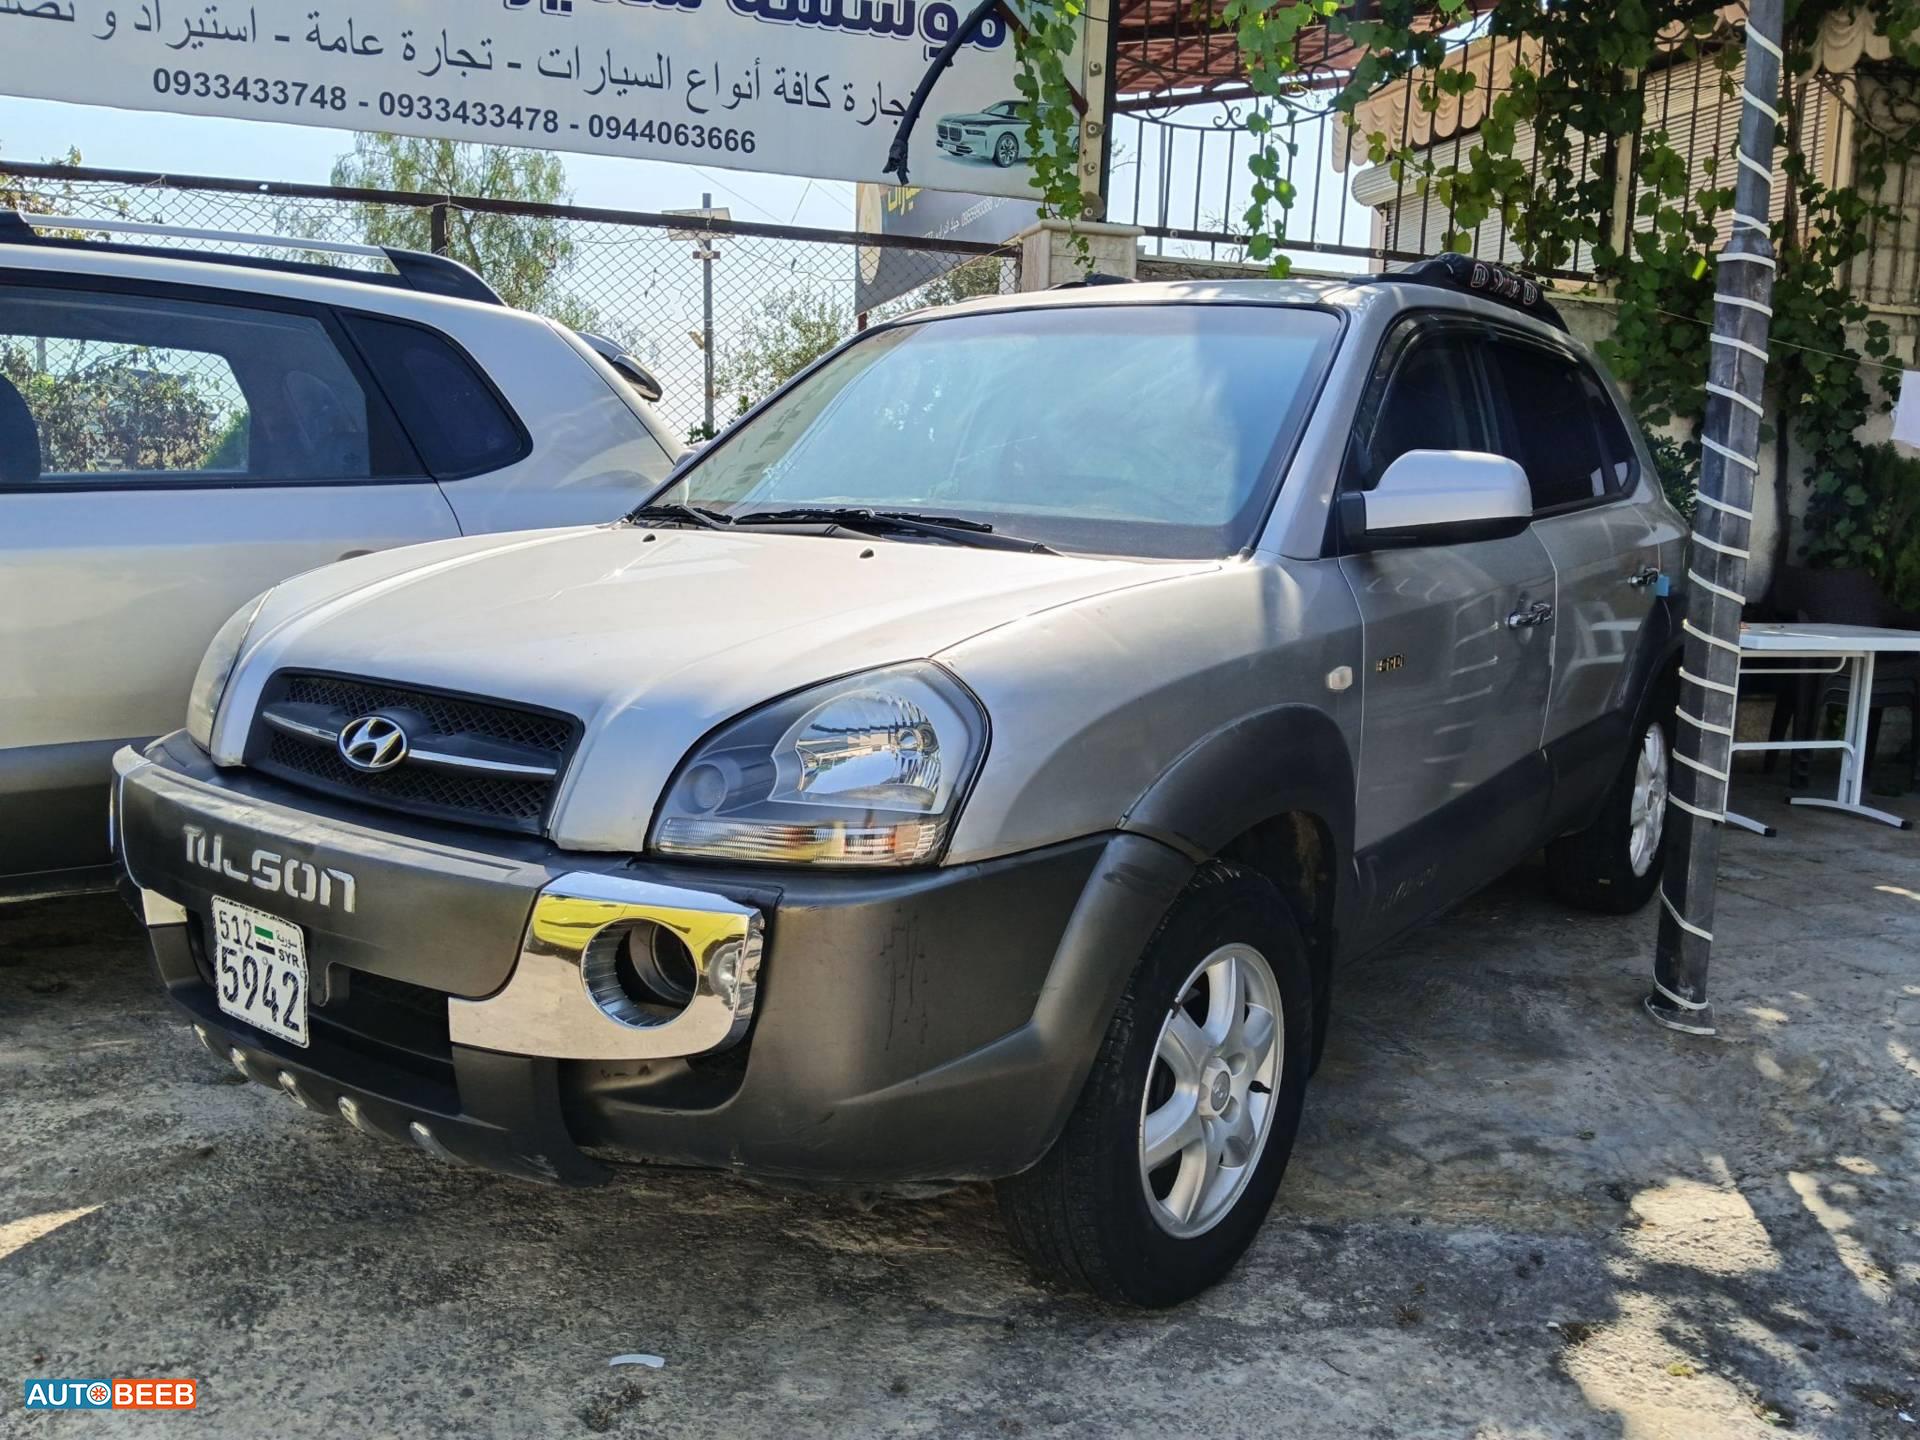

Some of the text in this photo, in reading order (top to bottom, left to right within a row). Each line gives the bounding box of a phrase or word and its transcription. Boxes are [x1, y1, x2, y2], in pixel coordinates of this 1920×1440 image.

[134, 0, 256, 50] استيراد
[305, 10, 384, 55] عامة
[402, 29, 493, 77] تجارة
[537, 45, 672, 96] السيارات
[153, 67, 347, 111] 0933433748
[378, 91, 559, 133] 0933433478
[588, 114, 756, 153] 0944063666
[686, 57, 760, 114] أنواع
[773, 66, 831, 109] كافة
[219, 910, 254, 950] 512
[278, 948, 300, 968] SYR
[221, 946, 300, 1032] 5942
